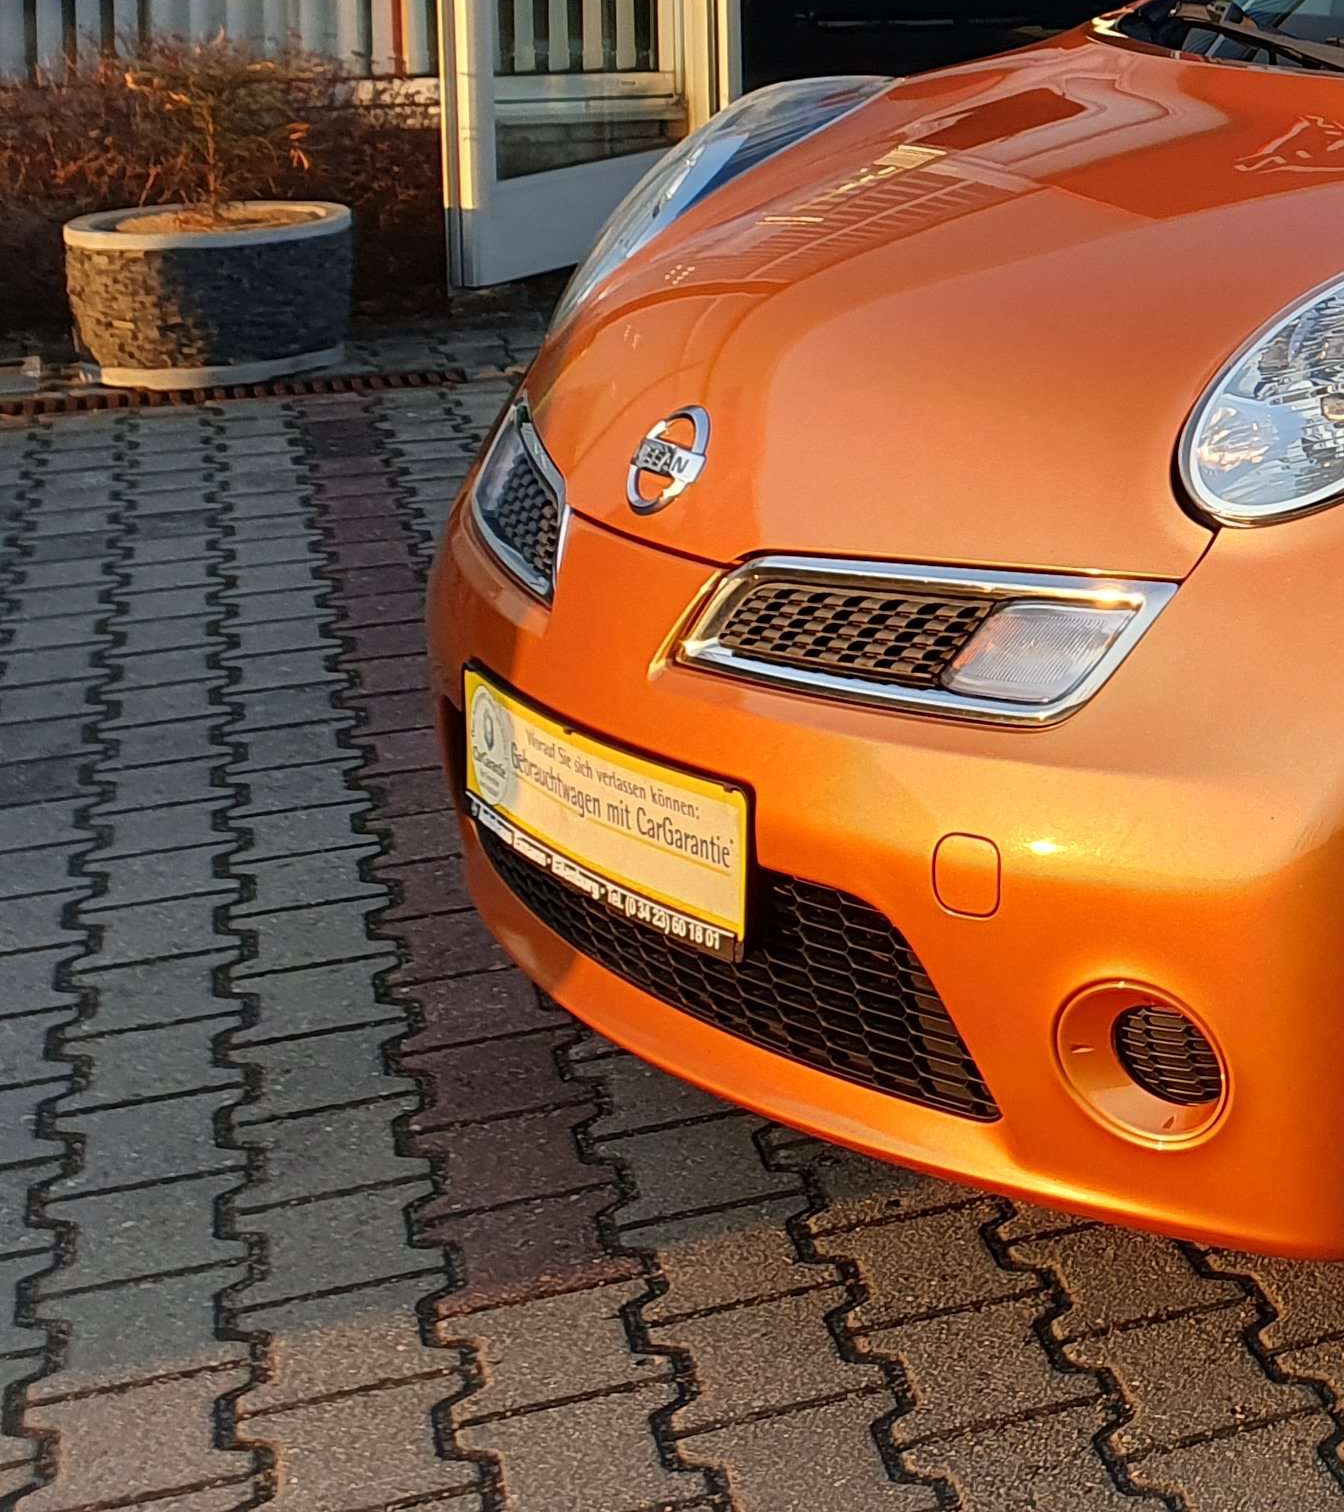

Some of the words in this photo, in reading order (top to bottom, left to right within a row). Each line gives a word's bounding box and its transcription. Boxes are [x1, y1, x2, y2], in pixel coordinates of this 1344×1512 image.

[511, 741, 601, 818] Gebrauchtwagen
[607, 800, 632, 830] mit
[557, 745, 572, 769] Sie
[574, 754, 593, 779] sich
[596, 768, 647, 801] verlassen
[650, 785, 700, 821] können:
[671, 917, 687, 937] 60
[688, 924, 704, 944] 18
[705, 930, 720, 950] 01
